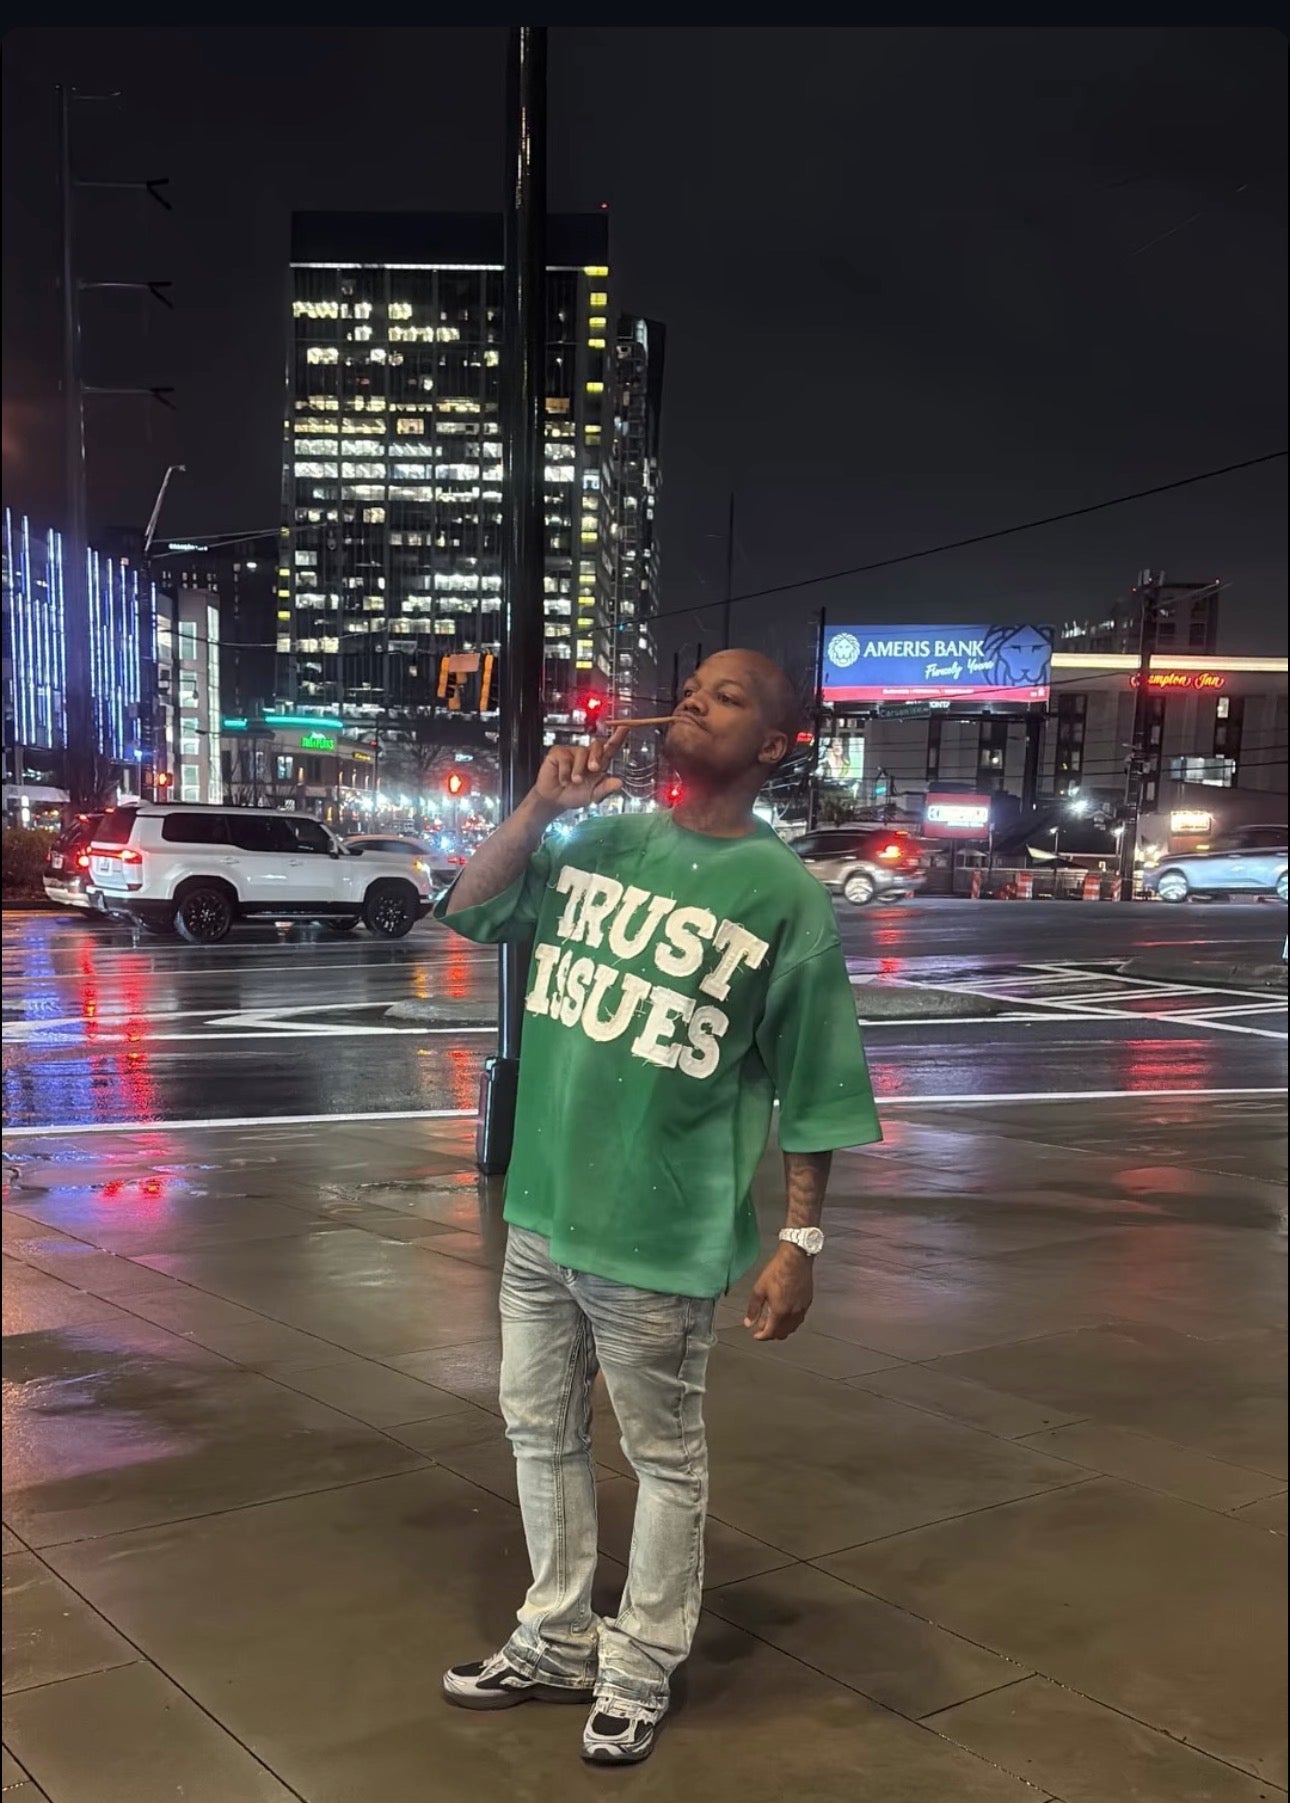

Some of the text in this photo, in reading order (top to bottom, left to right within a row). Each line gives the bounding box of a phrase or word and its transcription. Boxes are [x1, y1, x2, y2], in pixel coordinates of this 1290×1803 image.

[863, 640, 985, 658] AMERIS BANK
[556, 865, 769, 1001] TRUST
[526, 943, 729, 1079] ISSUES
